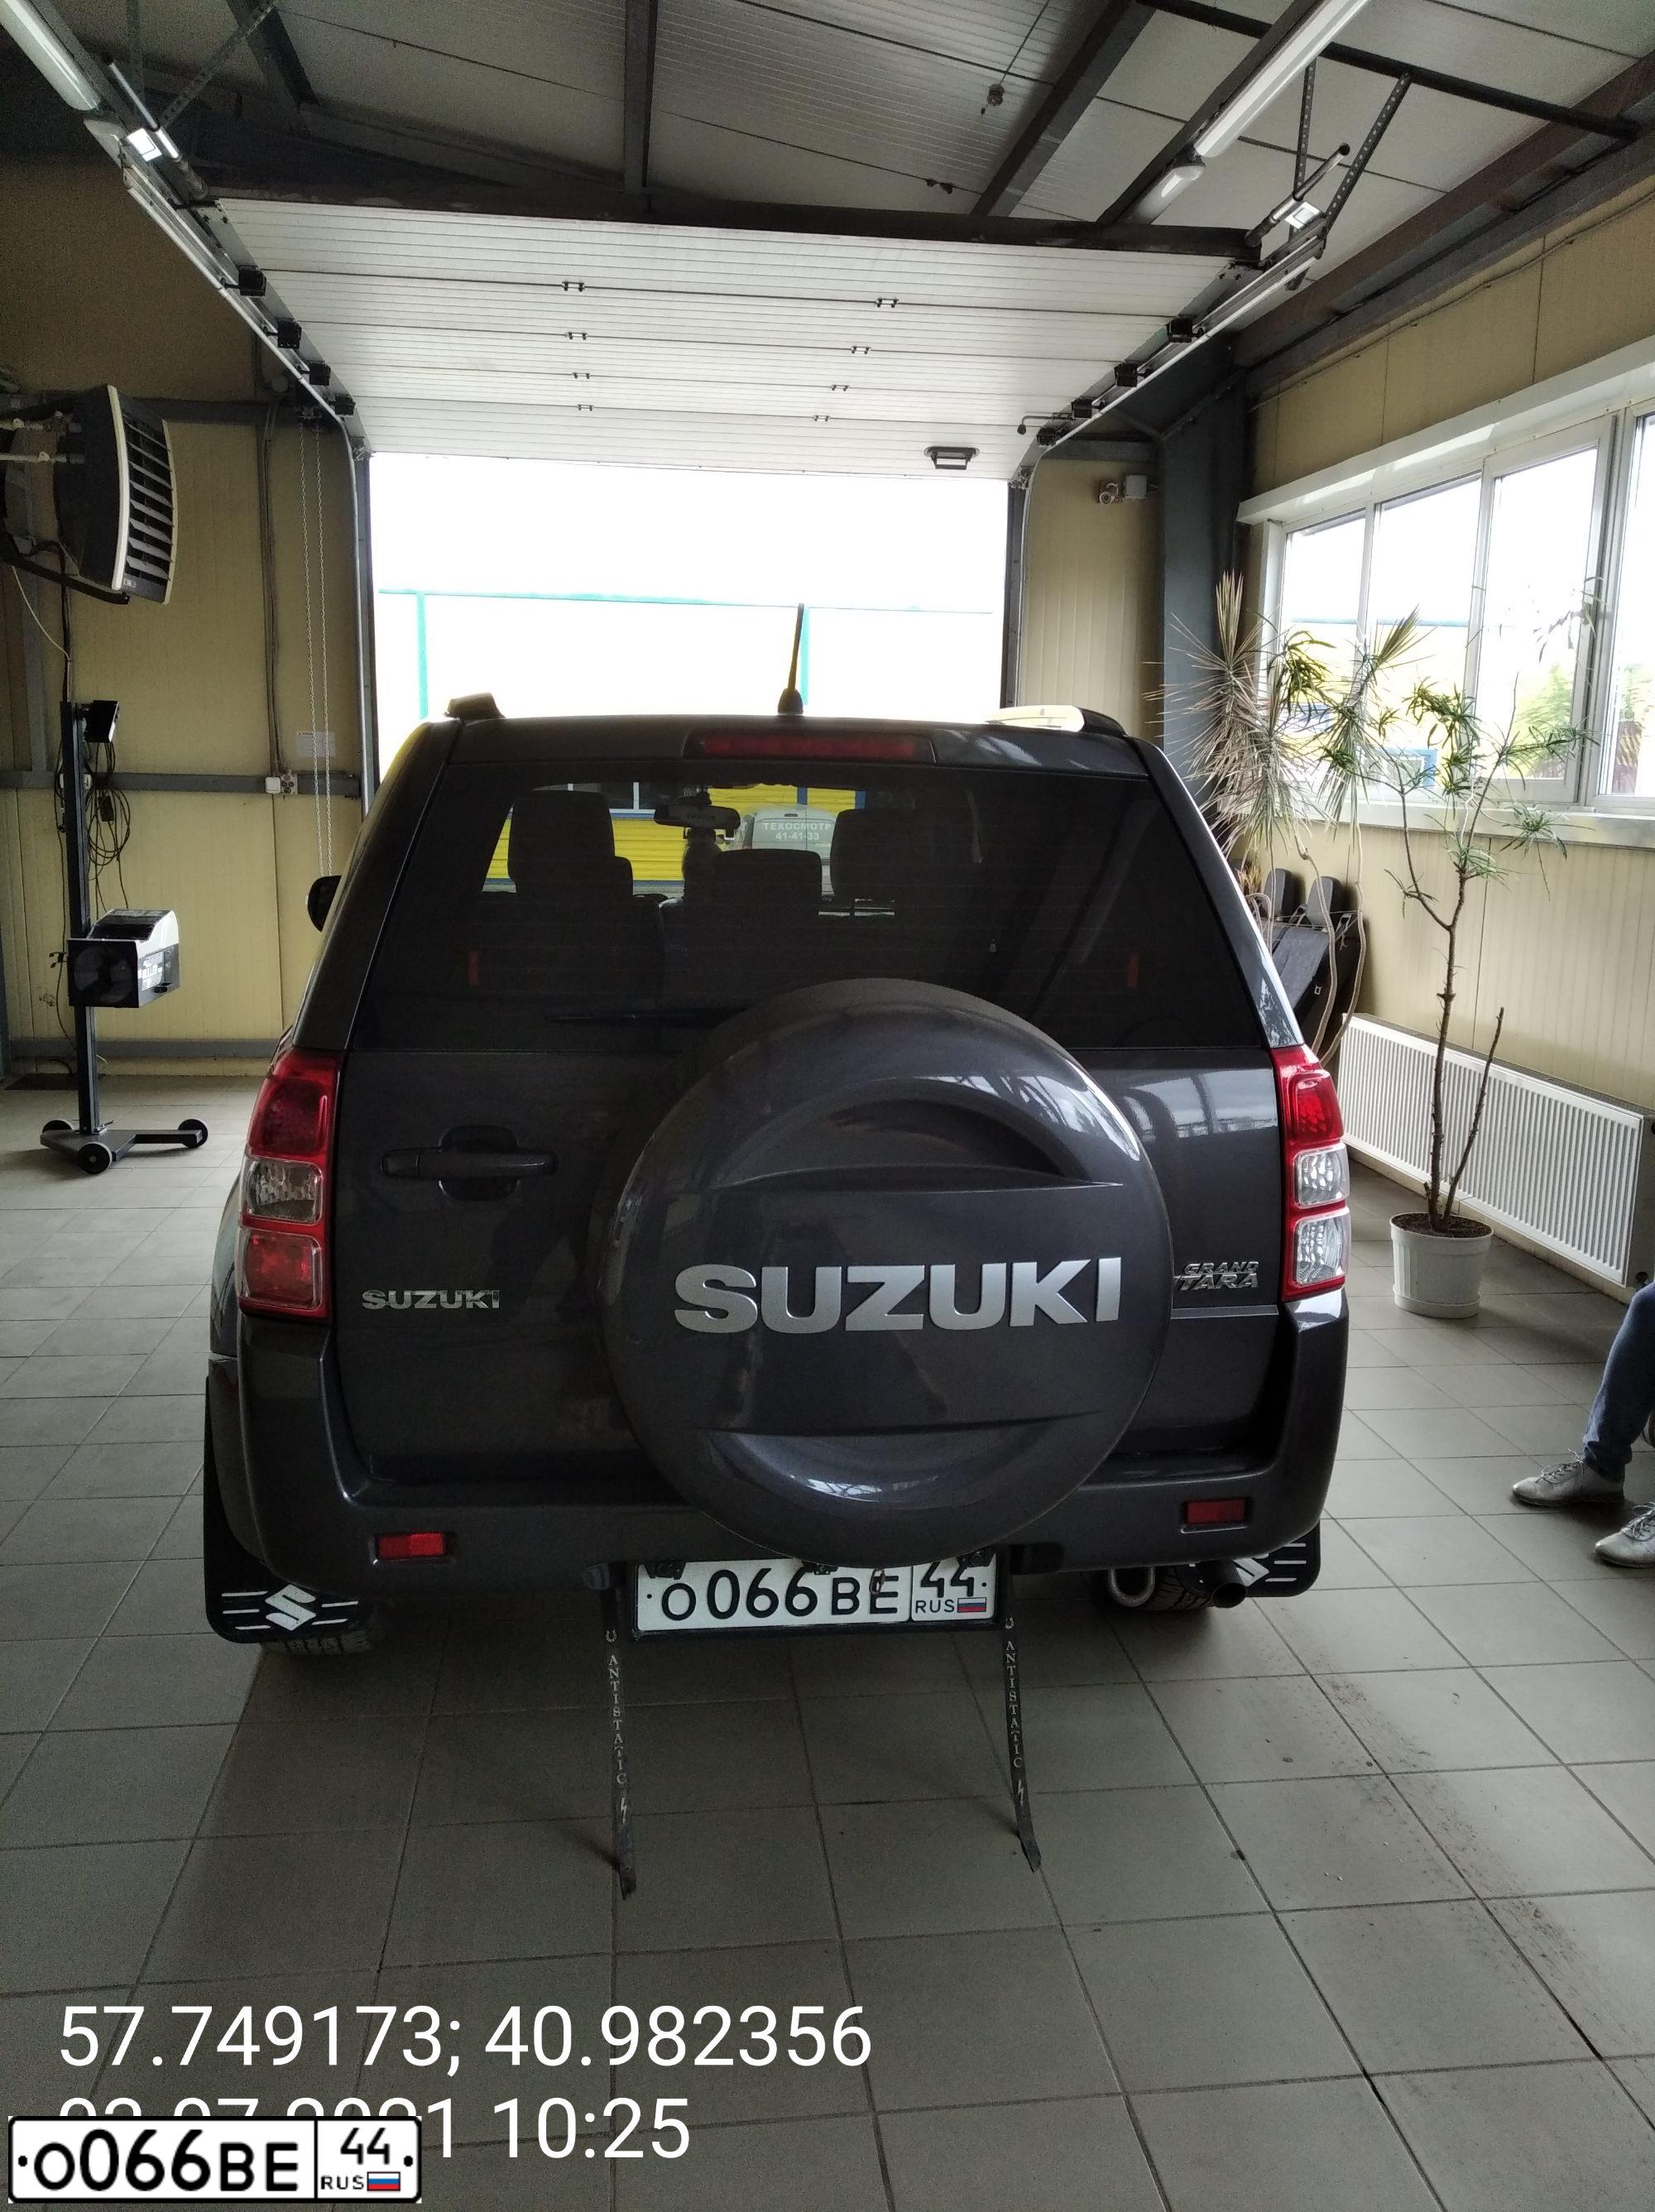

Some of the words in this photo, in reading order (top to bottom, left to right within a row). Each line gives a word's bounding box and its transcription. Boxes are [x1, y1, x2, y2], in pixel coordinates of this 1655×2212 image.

[775, 832, 819, 841] 41-41-33
[1184, 1261, 1259, 1274] GRAND
[1173, 1273, 1259, 1291] TARA
[362, 1289, 500, 1310] SUZUKI
[674, 1256, 1122, 1334] SUZUKI
[920, 1561, 975, 1598] 44
[915, 1599, 955, 1614] RUS
[1006, 1640, 1023, 1768] ANTISTATIC
[608, 1654, 627, 1785] ANTISTATIC
